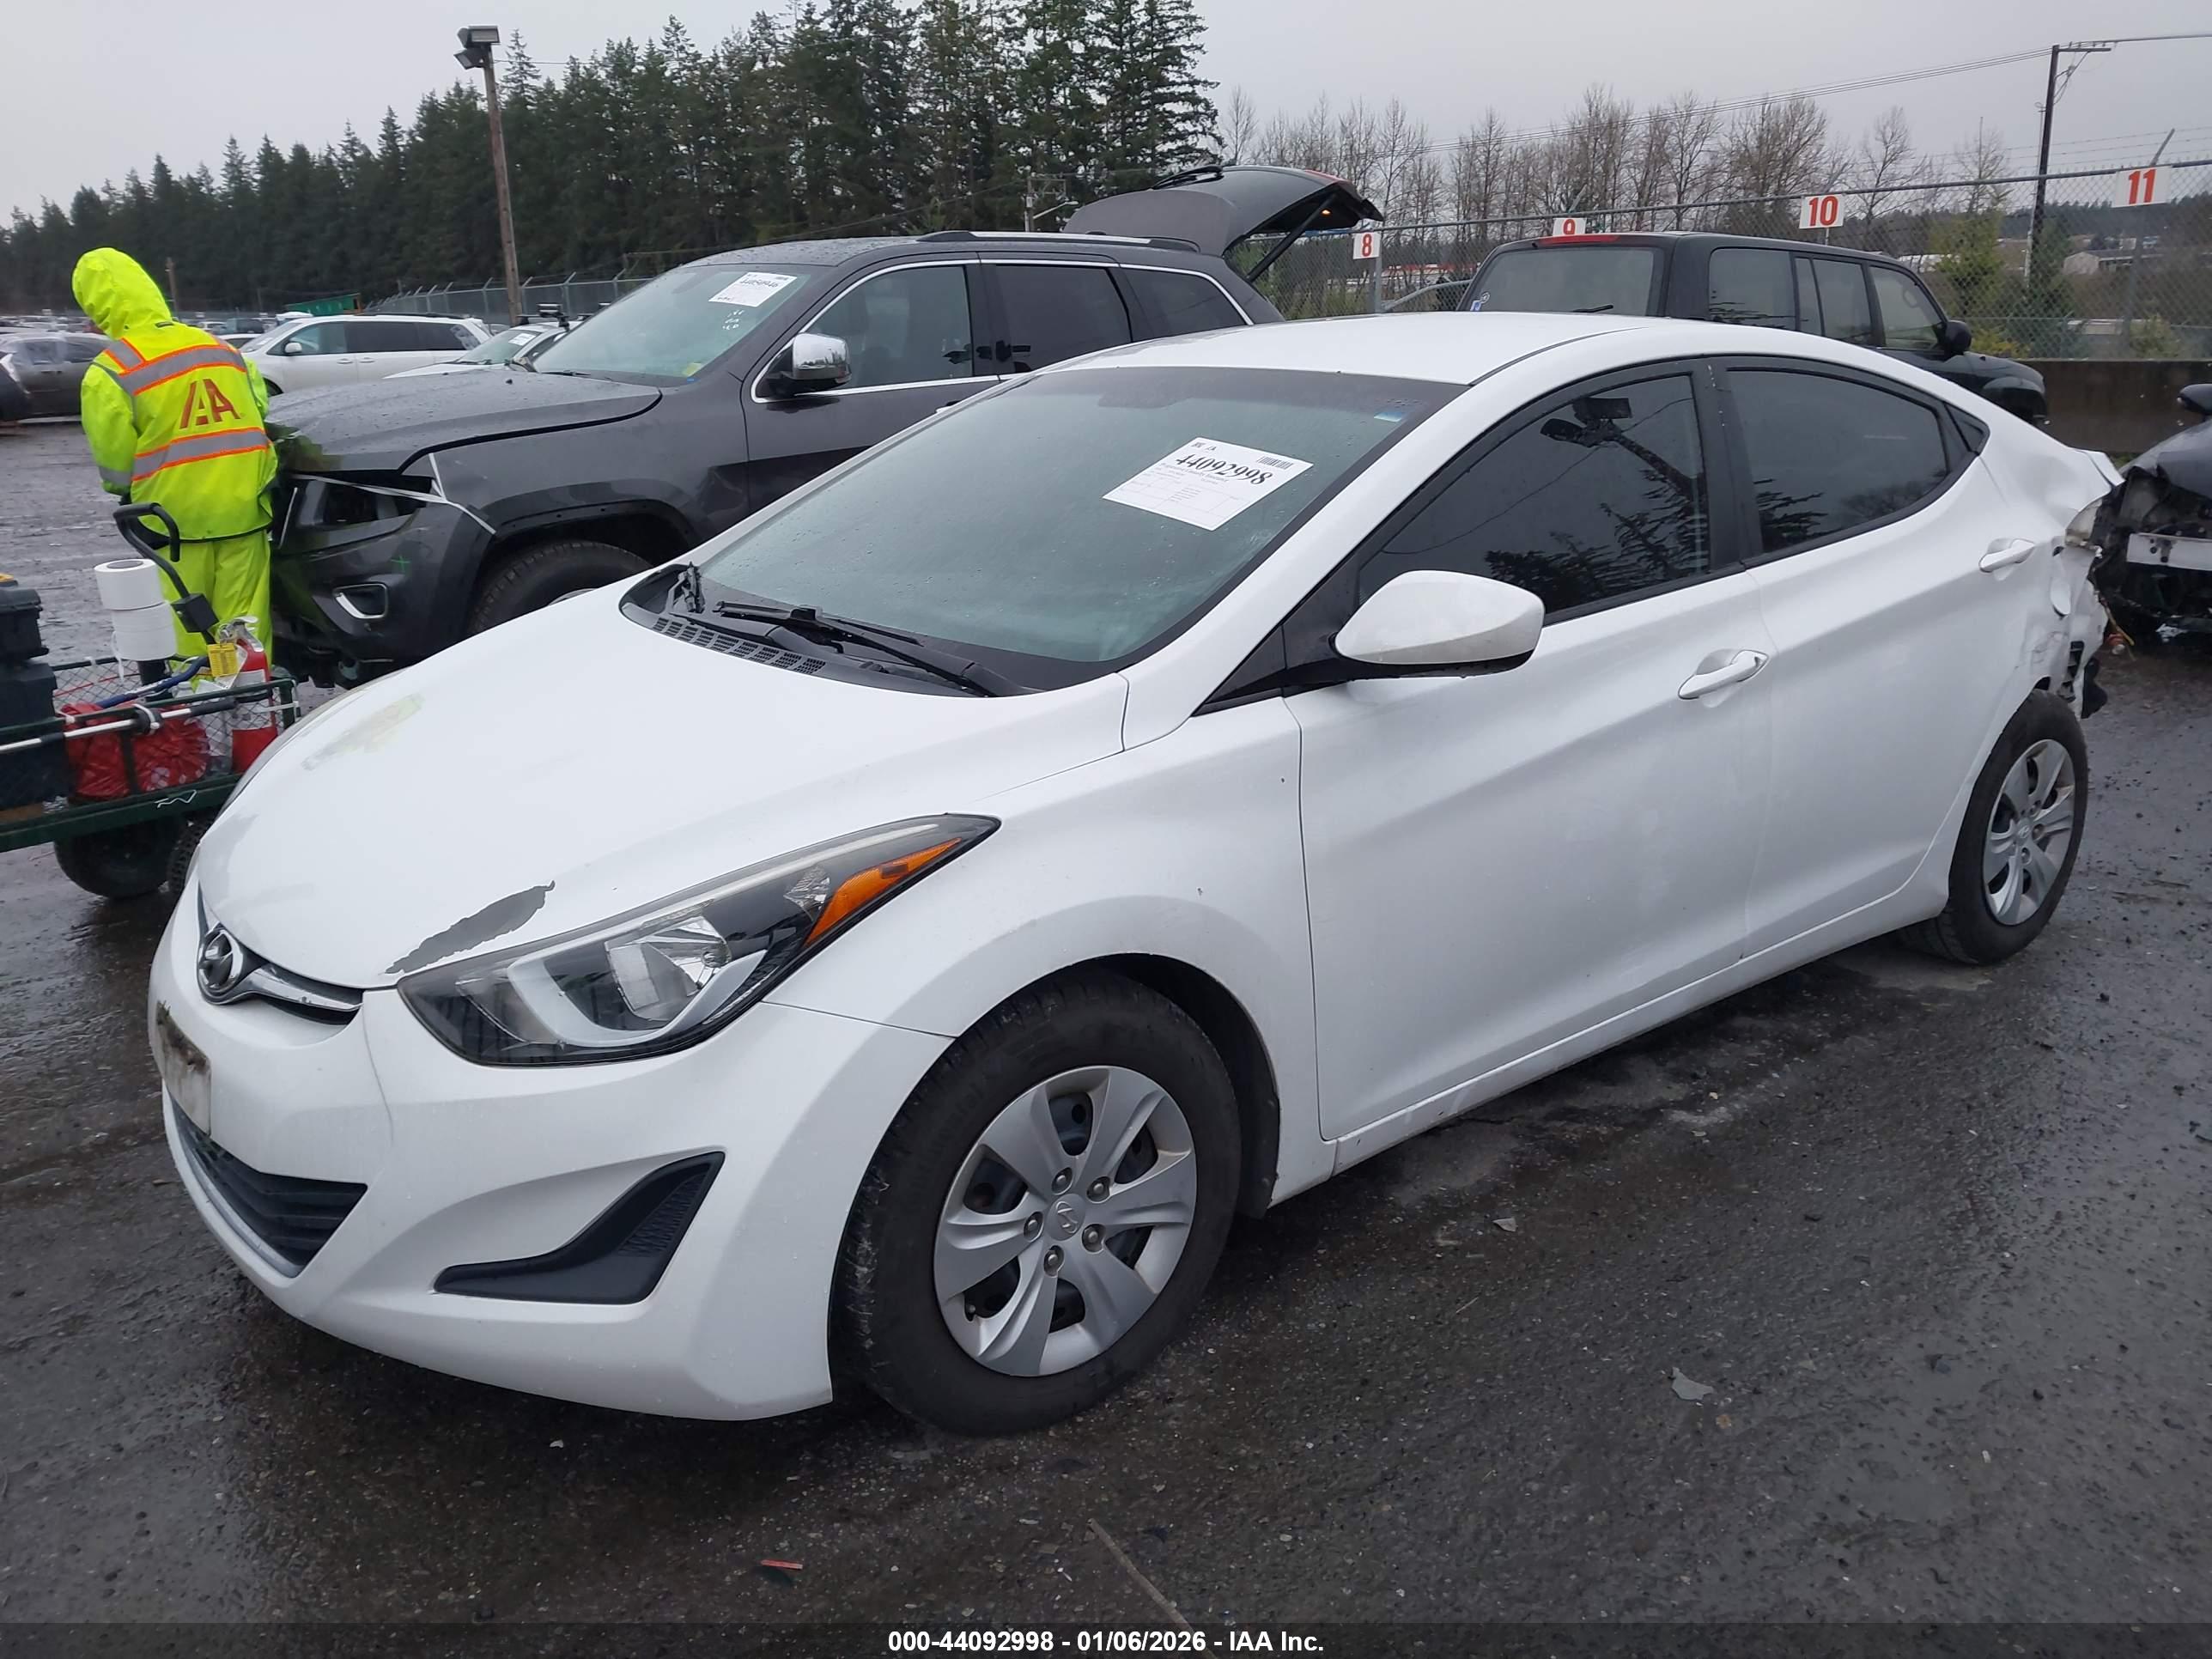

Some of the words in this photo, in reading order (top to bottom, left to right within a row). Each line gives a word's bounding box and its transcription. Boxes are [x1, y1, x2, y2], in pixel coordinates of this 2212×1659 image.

[2129, 168, 2156, 204] 11
[1808, 196, 1838, 227] 10
[1362, 233, 1372, 257] 8
[1176, 453, 1273, 484] 44092998
